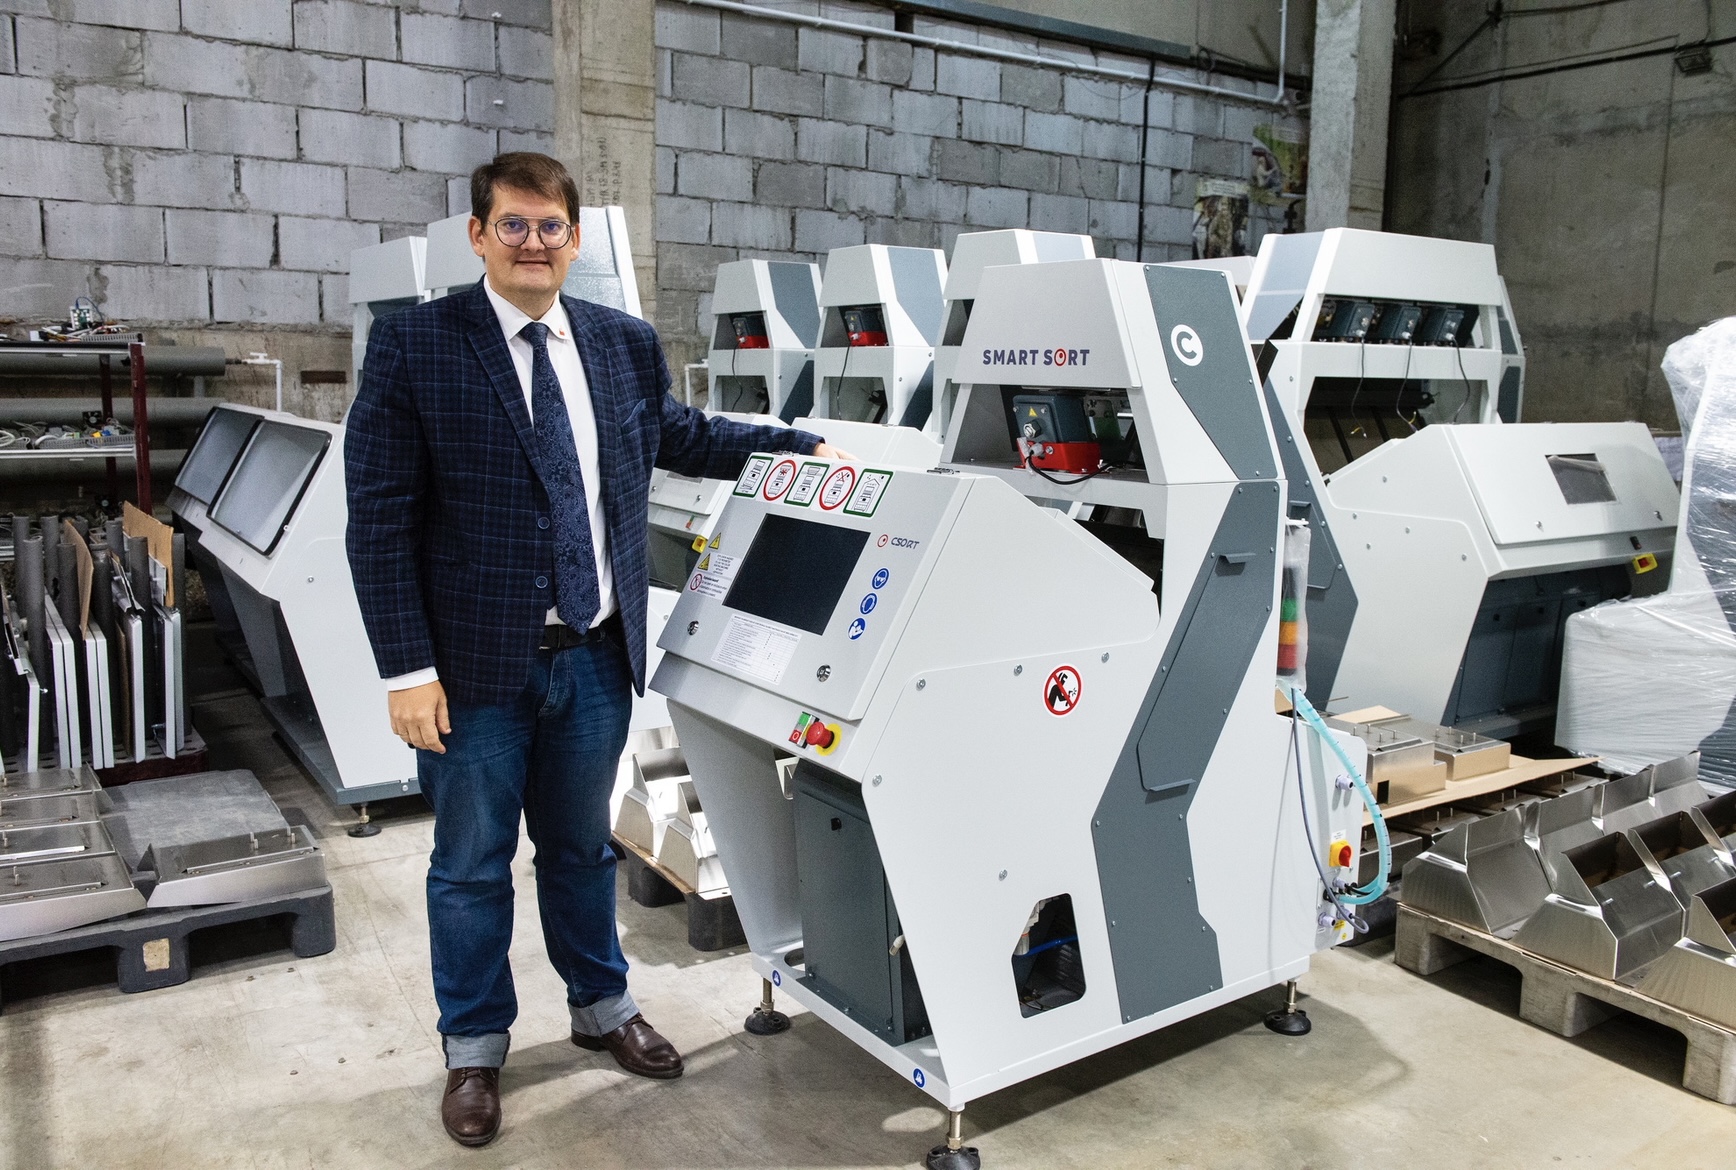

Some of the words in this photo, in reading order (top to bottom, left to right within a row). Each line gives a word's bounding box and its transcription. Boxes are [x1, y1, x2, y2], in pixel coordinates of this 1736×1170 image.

[982, 349, 1039, 365] SMART
[1043, 348, 1090, 366] SORT
[891, 536, 920, 550] CSORT
